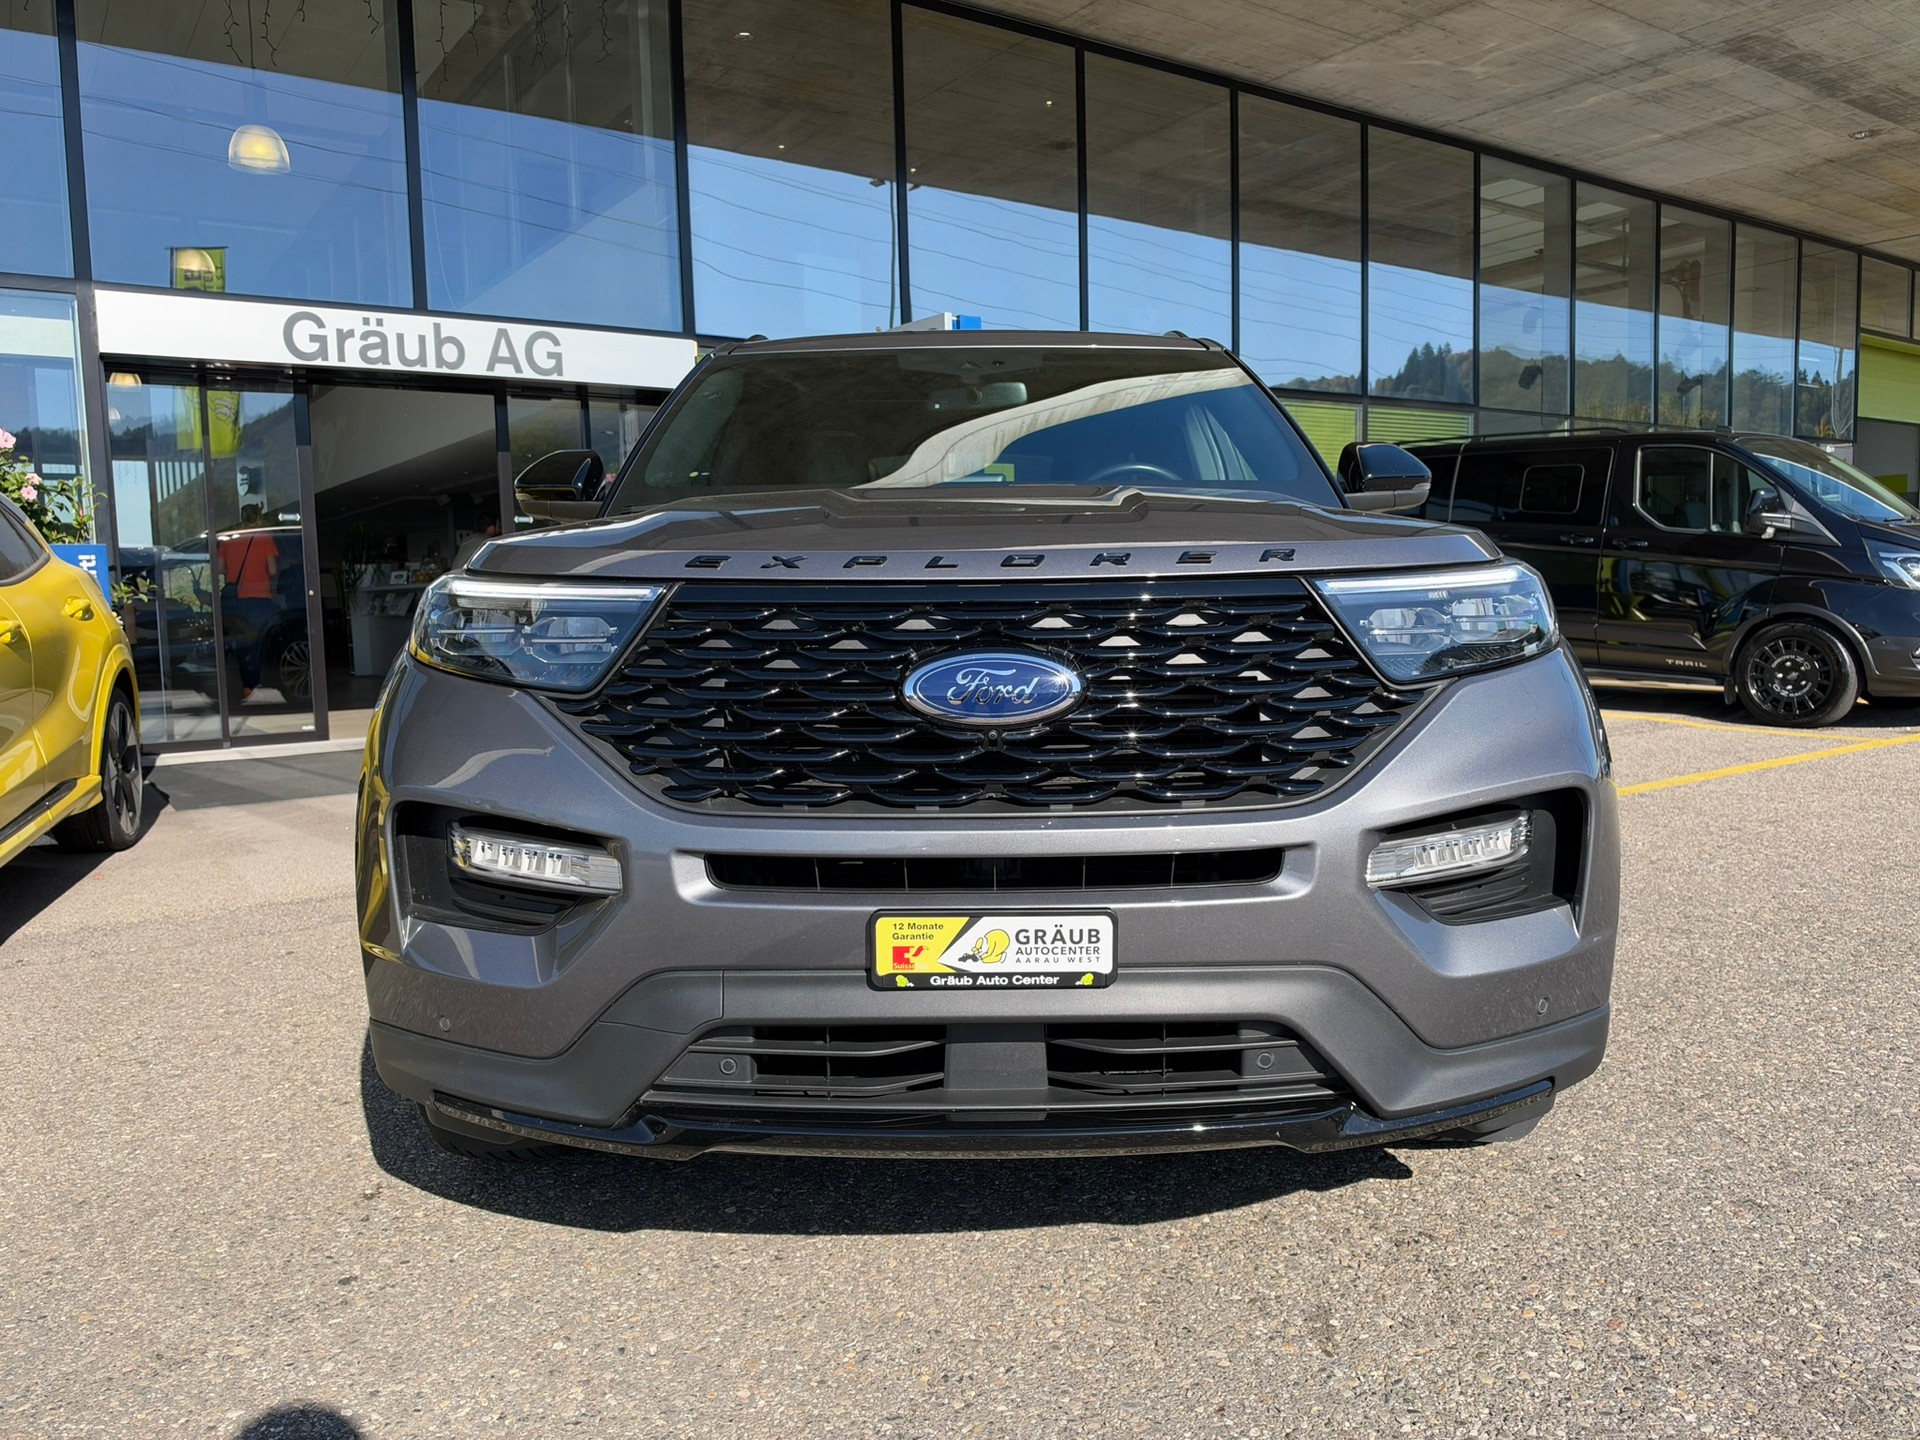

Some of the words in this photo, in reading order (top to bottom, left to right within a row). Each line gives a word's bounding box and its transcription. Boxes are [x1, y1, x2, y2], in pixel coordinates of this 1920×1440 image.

[282, 310, 466, 371] Gräub
[485, 327, 565, 377] AG
[684, 548, 1296, 570] EXPLORER
[1665, 658, 1707, 668] TRAIL
[947, 667, 1041, 705] Ford
[907, 922, 944, 930] Monate
[892, 932, 934, 940] Garantie
[1015, 924, 1101, 945] GRÄUB
[1016, 946, 1100, 955] AUTOCENTER
[930, 975, 973, 985] Gräub
[976, 976, 1009, 985] Auto
[1012, 974, 1060, 985] Center
